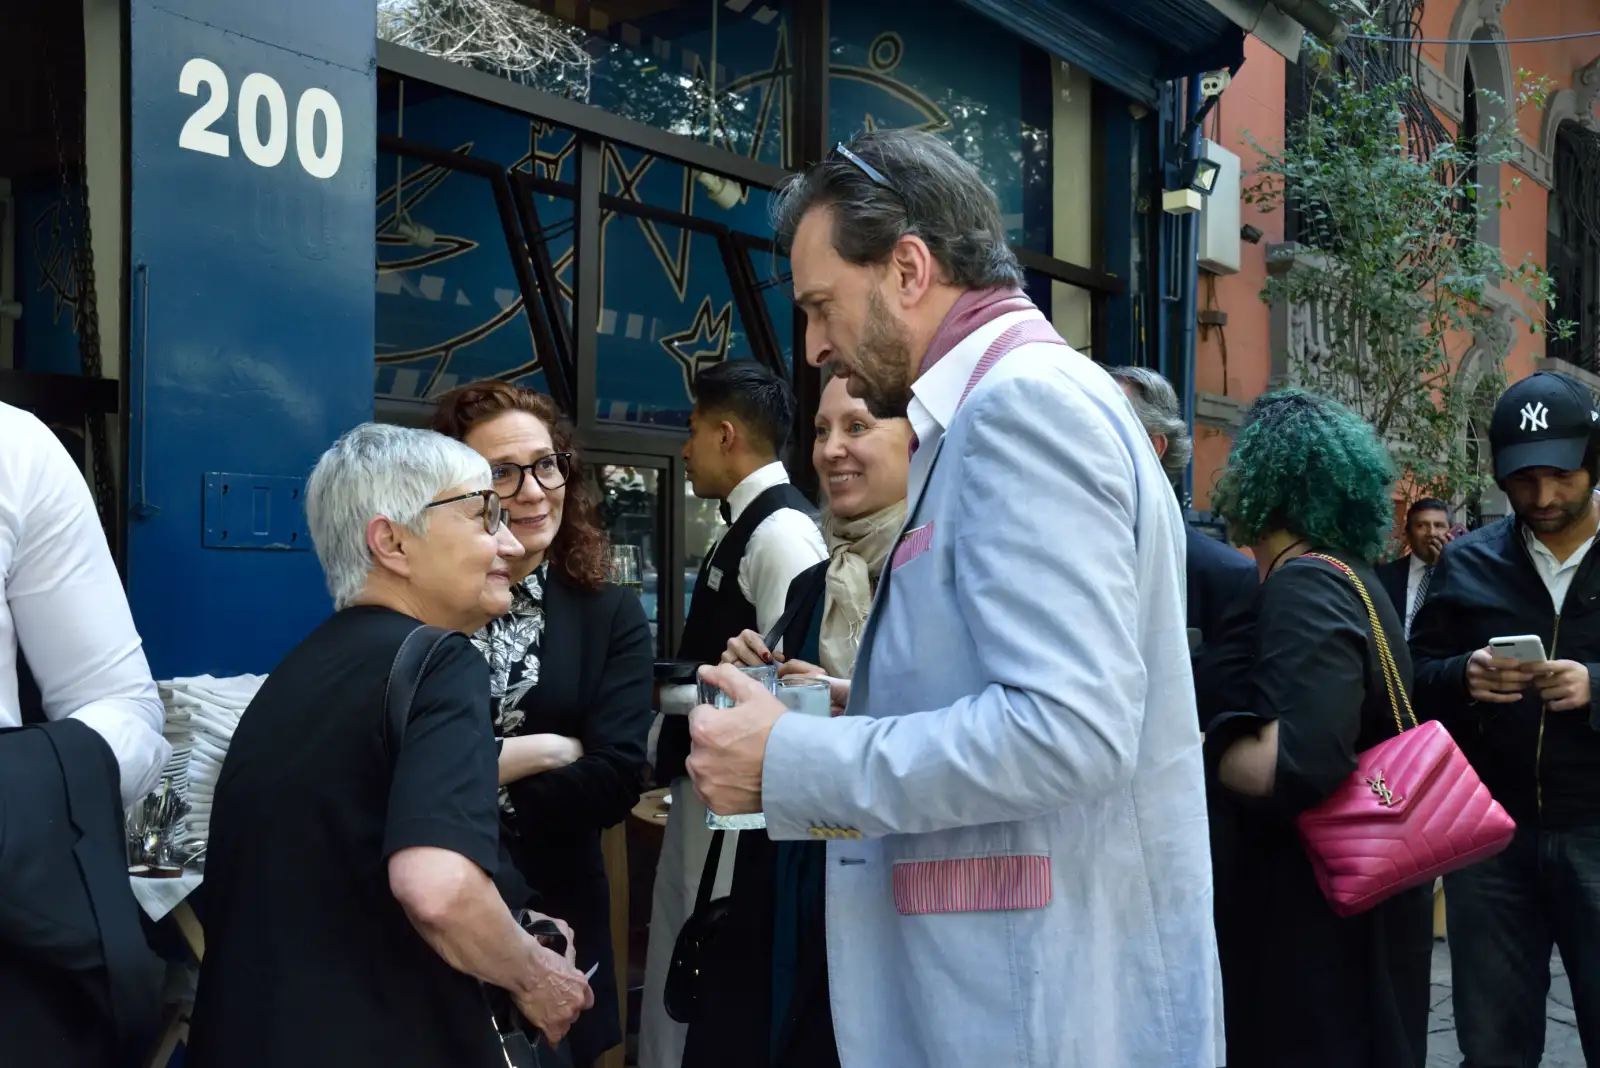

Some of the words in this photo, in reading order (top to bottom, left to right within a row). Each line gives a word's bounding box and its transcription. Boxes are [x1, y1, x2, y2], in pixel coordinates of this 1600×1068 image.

[178, 58, 344, 179] 200
[1519, 401, 1549, 432] NY
[1365, 770, 1403, 807] YSL
